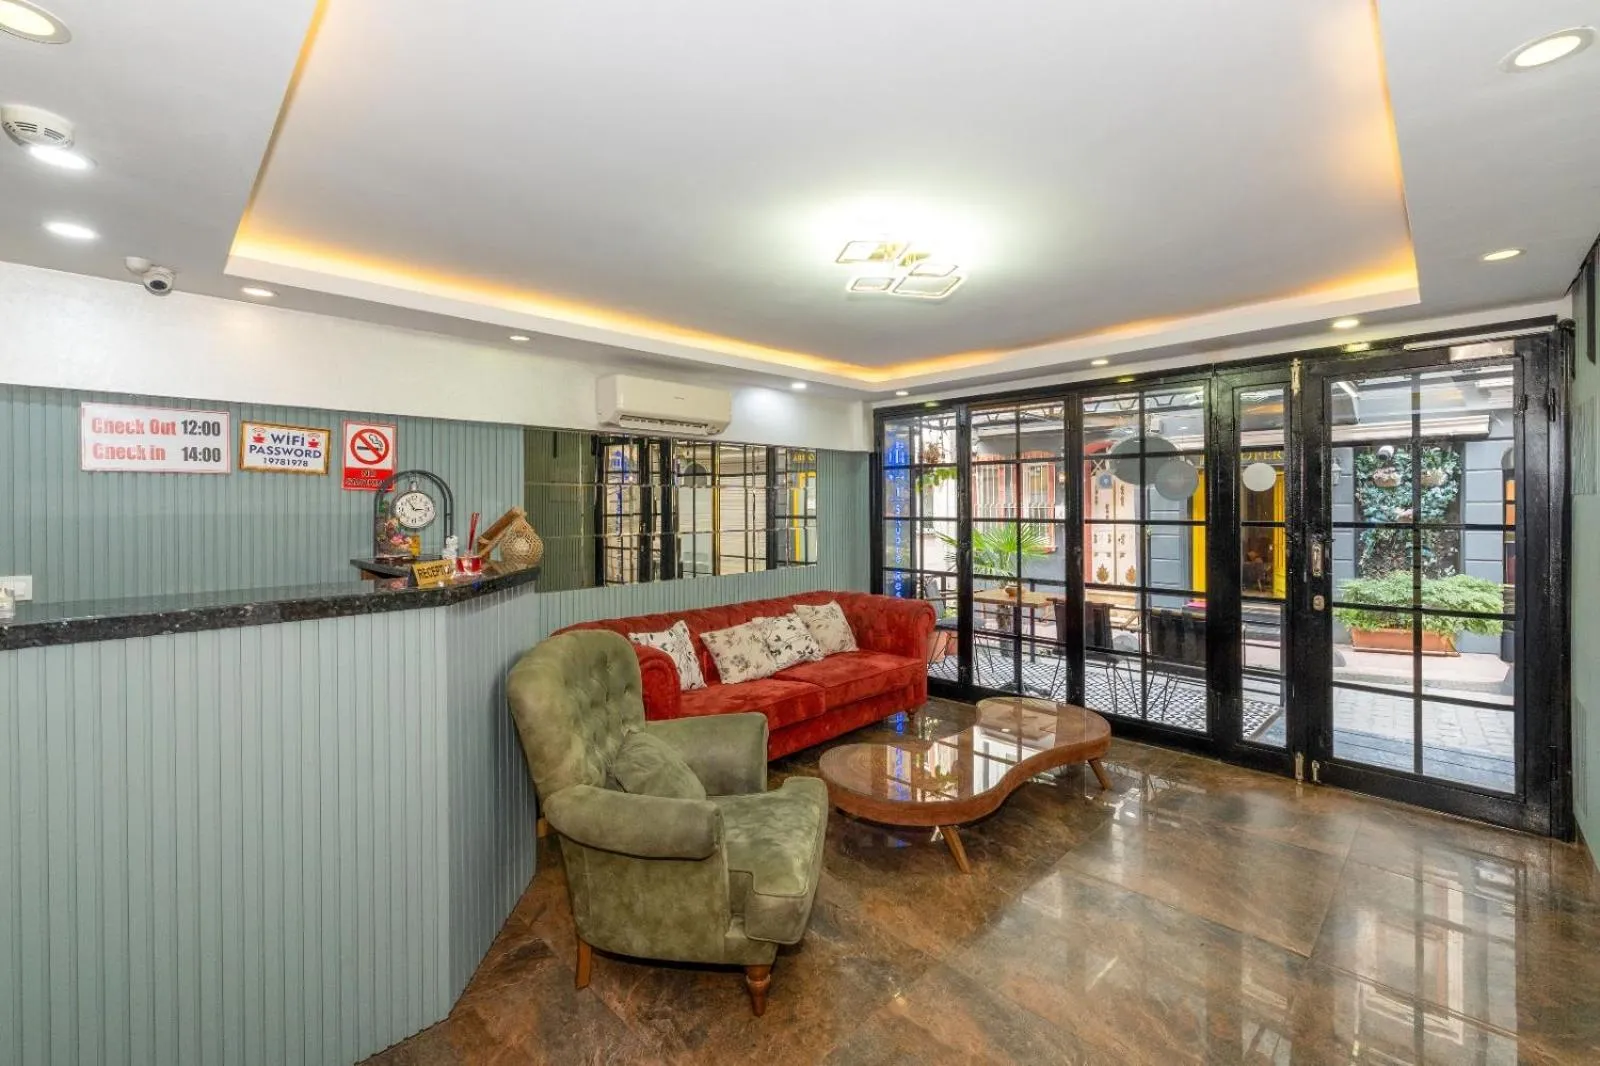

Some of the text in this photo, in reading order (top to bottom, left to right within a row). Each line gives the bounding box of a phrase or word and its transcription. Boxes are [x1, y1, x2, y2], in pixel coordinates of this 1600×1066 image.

[91, 417, 221, 437] Check Out 12:00
[92, 442, 221, 462] Check in 14:00
[249, 444, 322, 459] PASSWORD
[263, 457, 309, 467] 19781978
